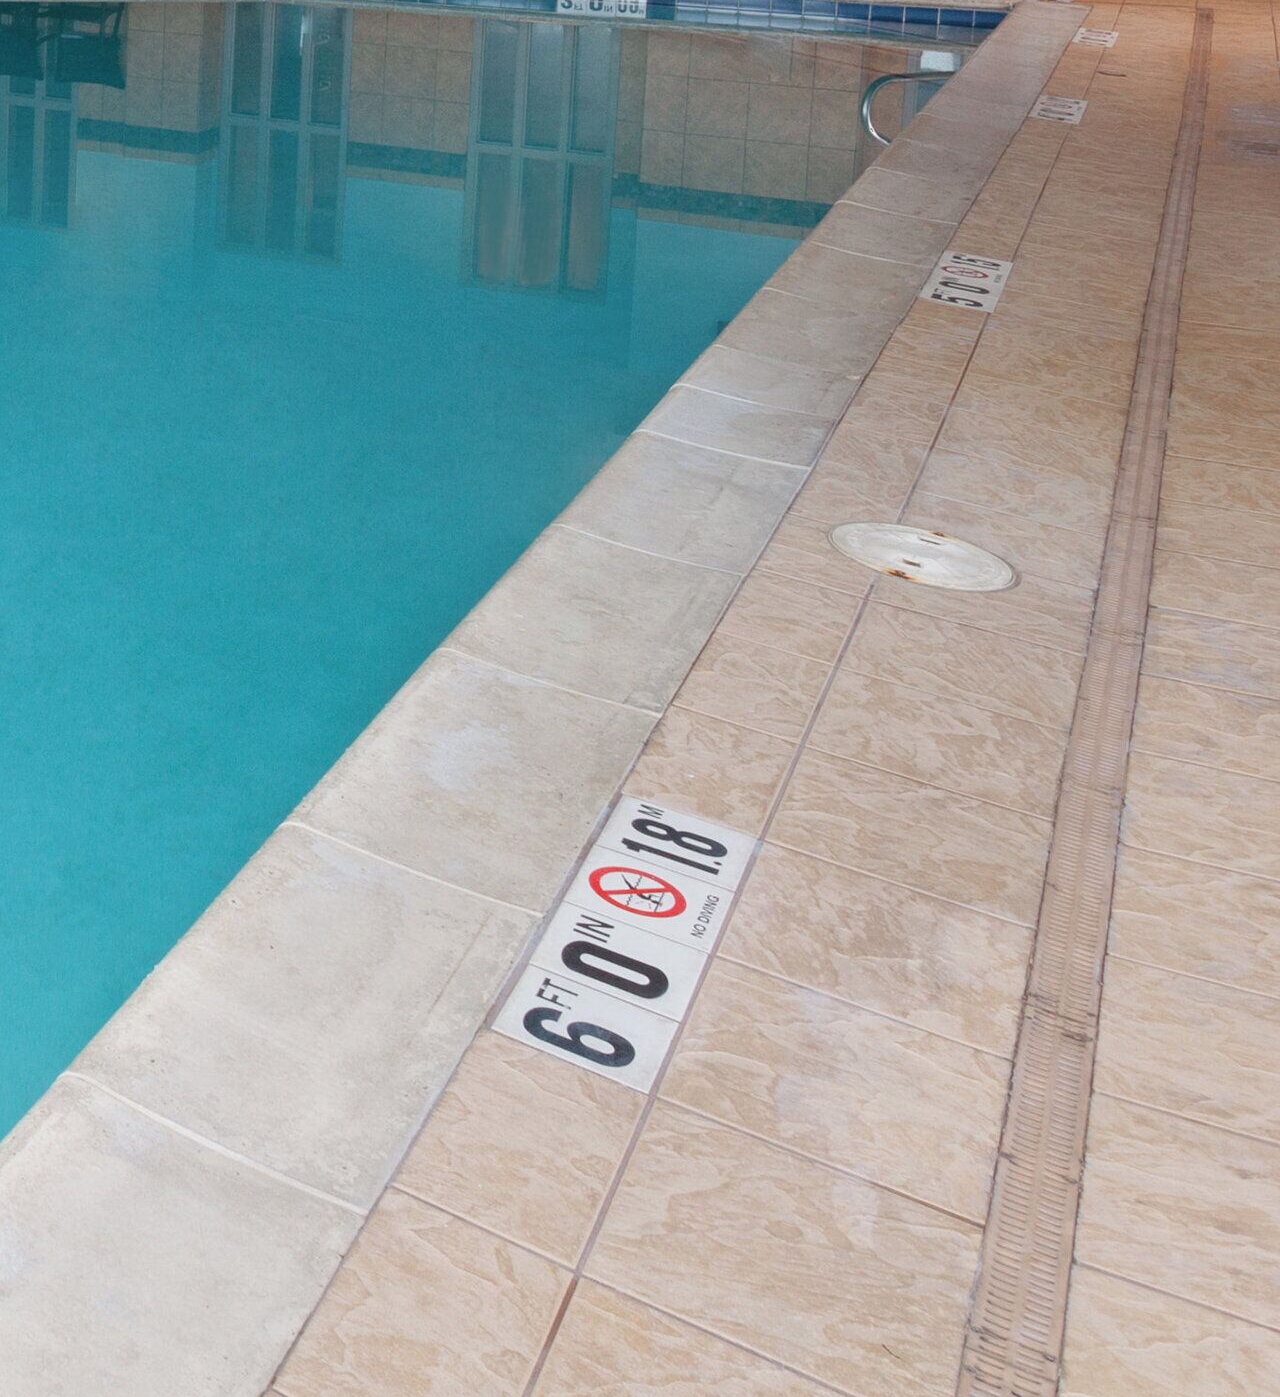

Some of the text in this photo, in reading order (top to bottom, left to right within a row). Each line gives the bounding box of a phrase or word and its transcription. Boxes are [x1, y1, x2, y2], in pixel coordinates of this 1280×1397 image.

[637, 804, 665, 819] M
[572, 914, 615, 943] IN
[690, 894, 719, 939] NO DIVING
[561, 940, 669, 999] 0
[535, 978, 578, 1010] FT
[523, 1007, 636, 1068] 6
